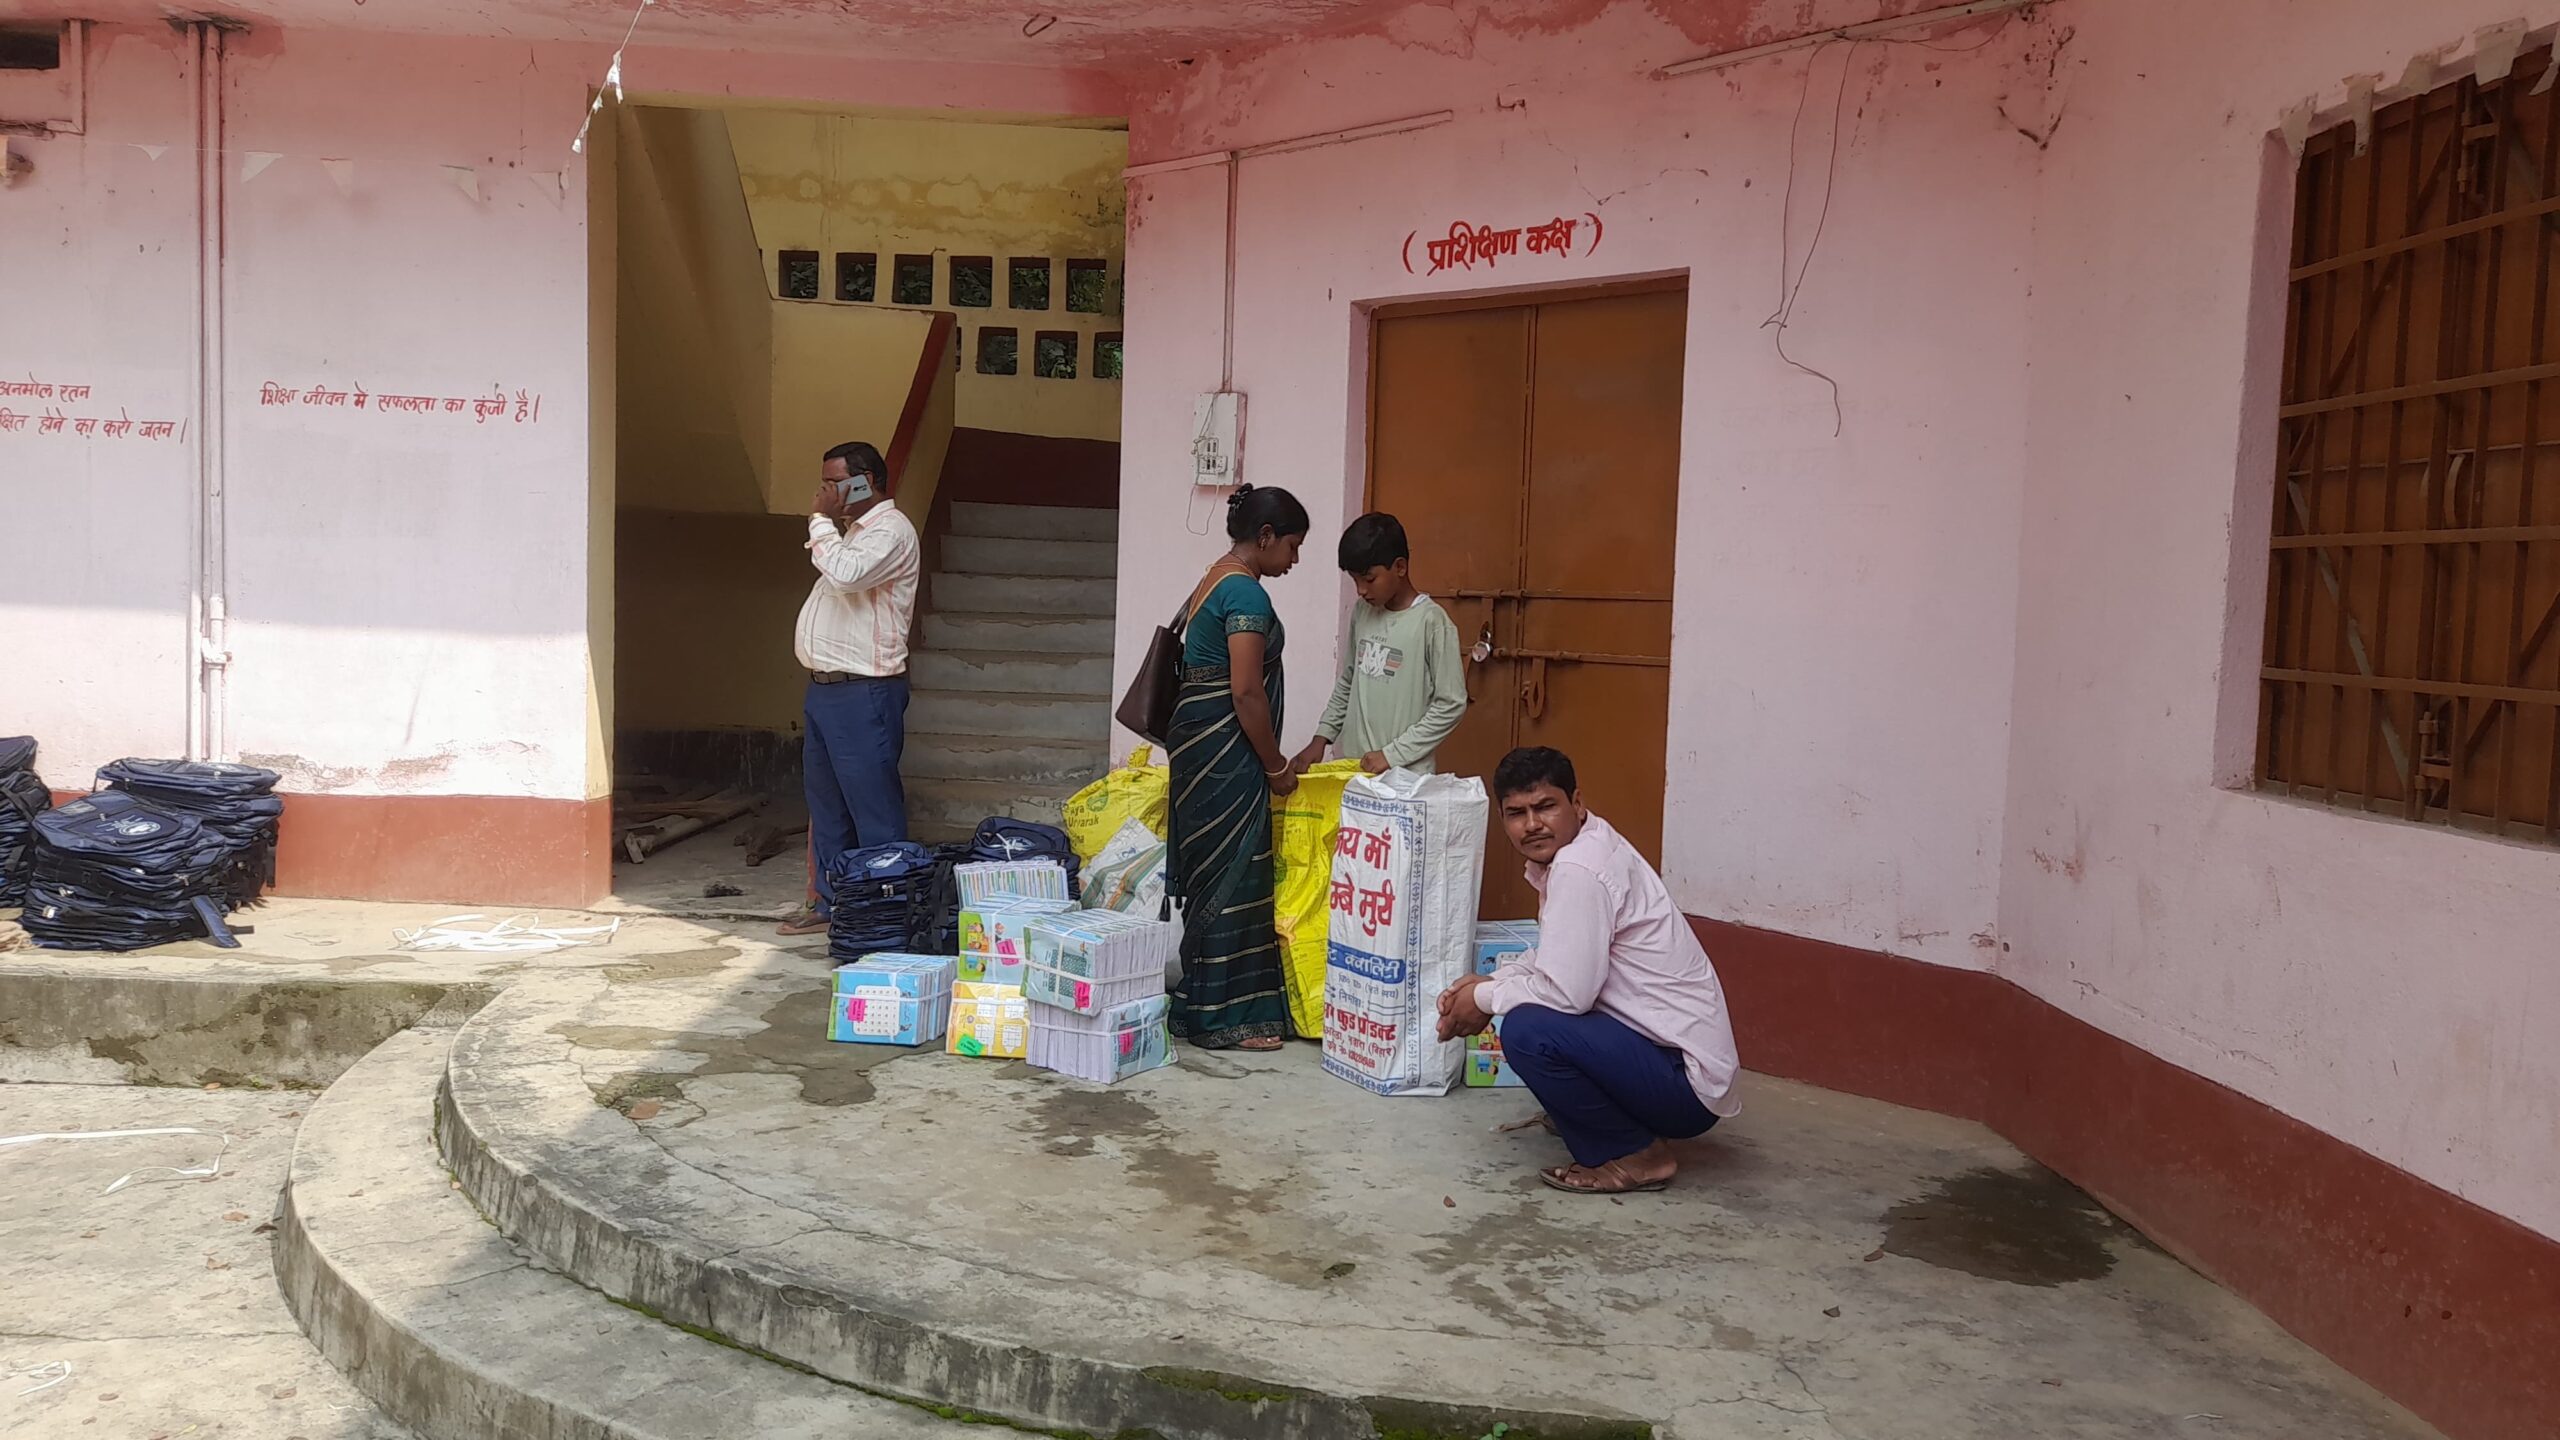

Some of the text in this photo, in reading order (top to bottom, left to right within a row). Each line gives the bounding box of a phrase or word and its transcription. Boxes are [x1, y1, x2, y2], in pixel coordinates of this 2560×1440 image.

[59, 384, 91, 402] रतन
[259, 380, 299, 406] शिक्षा
[302, 384, 348, 406] जीवन
[376, 394, 438, 414] सफलता
[443, 398, 466, 413] का
[0, 407, 30, 432] क्षित
[103, 406, 134, 439] करो
[1330, 872, 1355, 915] म्बे
